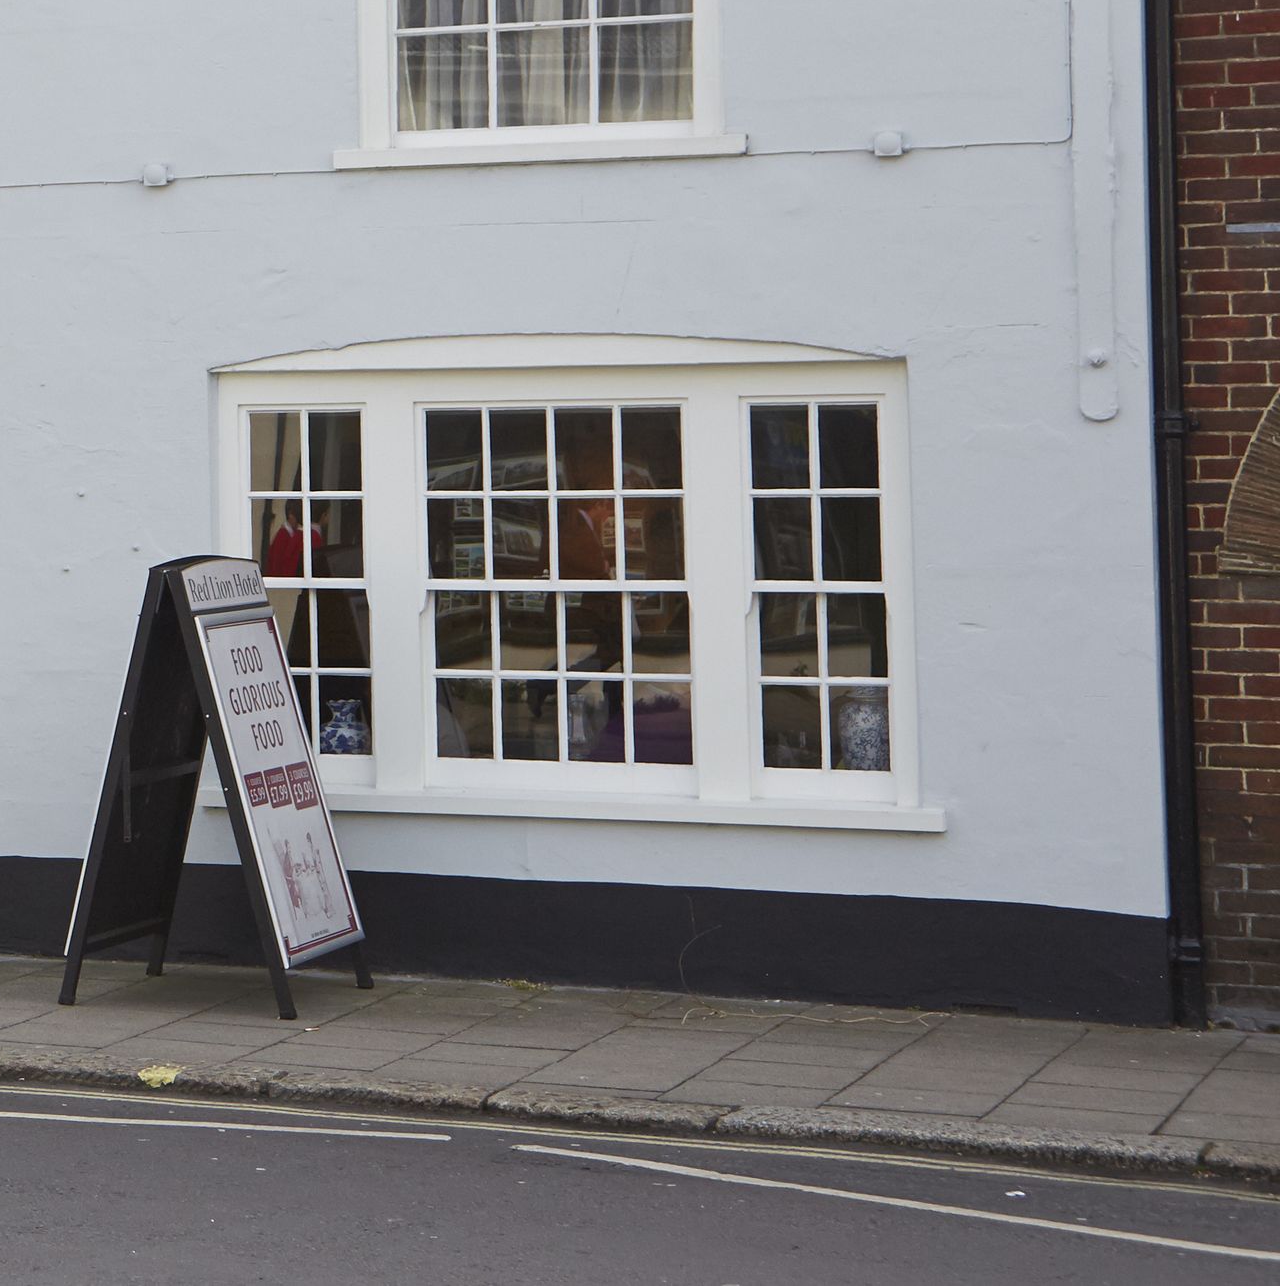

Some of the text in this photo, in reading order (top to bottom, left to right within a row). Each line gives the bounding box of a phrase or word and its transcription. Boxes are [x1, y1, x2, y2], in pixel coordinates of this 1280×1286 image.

[187, 569, 263, 603] Red Lion Hotel
[230, 645, 263, 676] FOOD
[229, 680, 285, 716] GLORIOUS
[250, 719, 284, 752] FOOD
[270, 784, 289, 803] £7.99
[293, 780, 314, 803] £9.99
